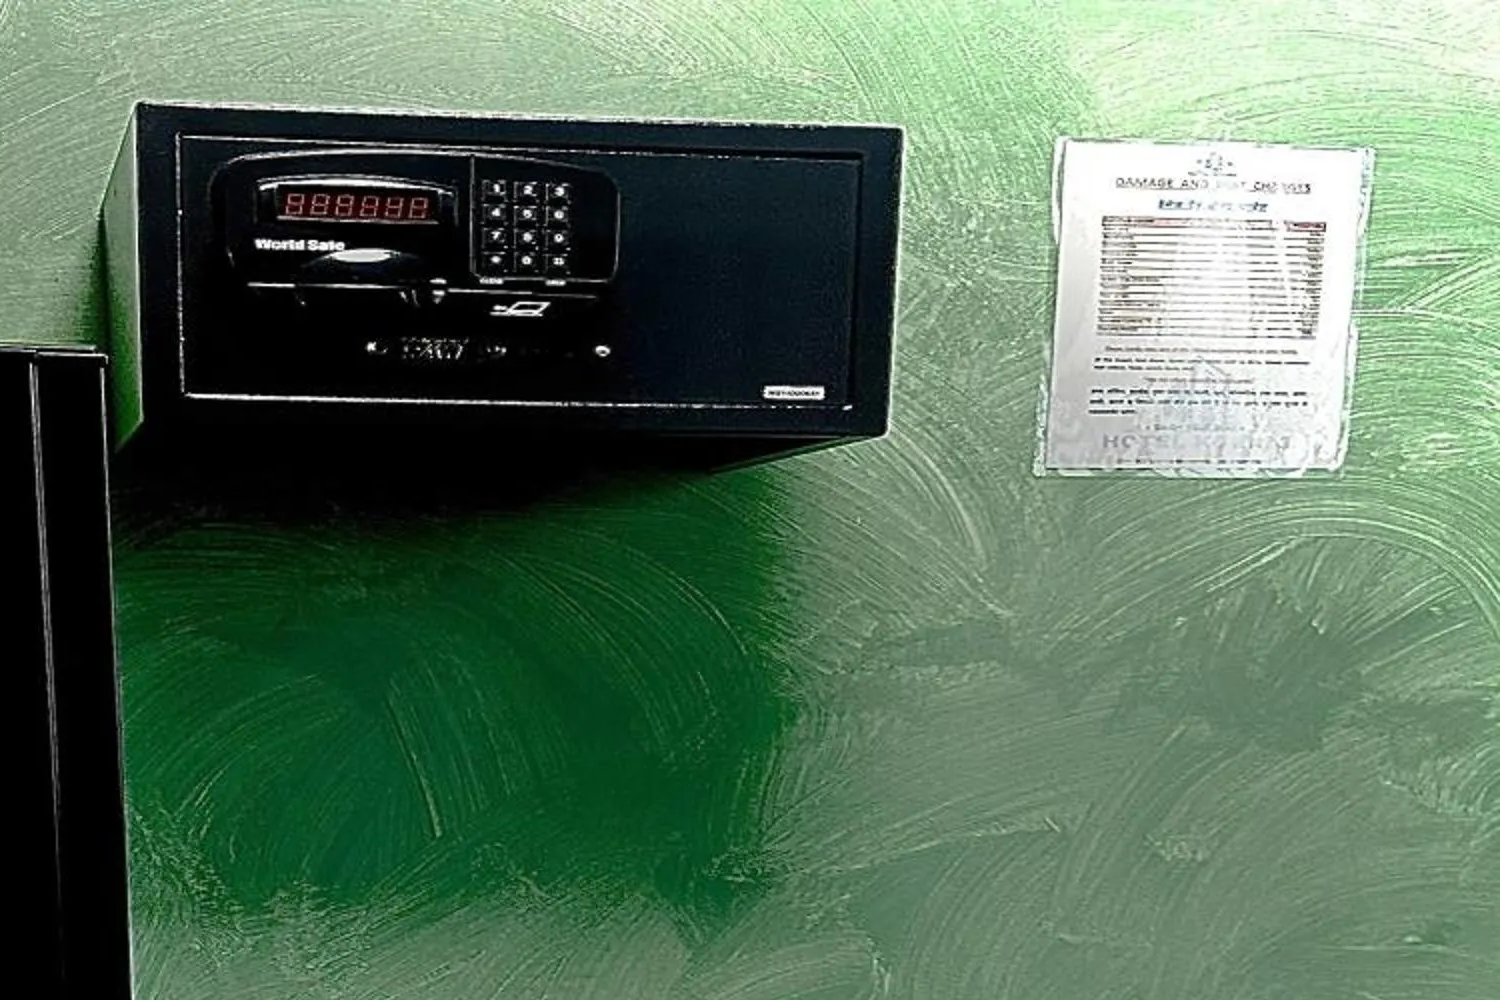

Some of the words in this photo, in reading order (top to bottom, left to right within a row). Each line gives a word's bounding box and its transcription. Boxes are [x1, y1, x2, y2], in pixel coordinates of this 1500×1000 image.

[1115, 177, 1174, 188] DAMAGE
[254, 238, 305, 251] World
[307, 240, 345, 252] Safe
